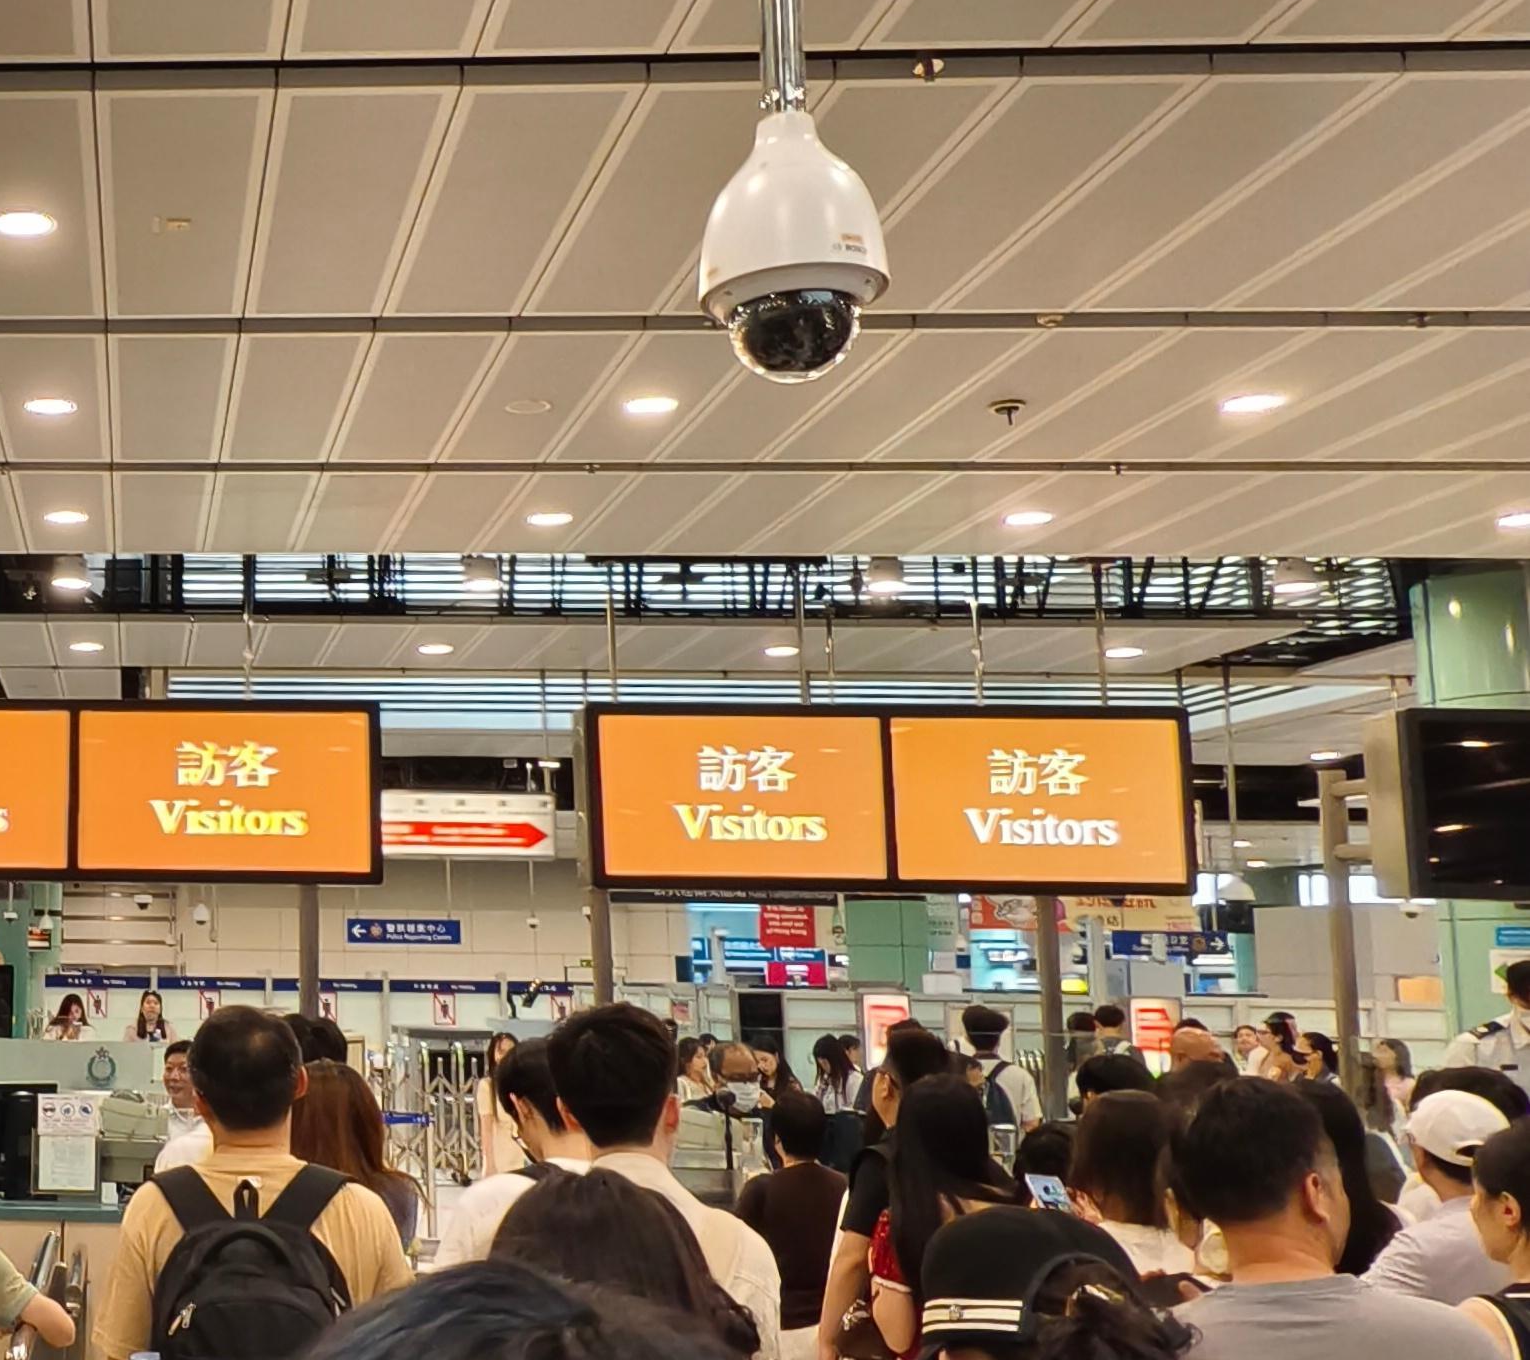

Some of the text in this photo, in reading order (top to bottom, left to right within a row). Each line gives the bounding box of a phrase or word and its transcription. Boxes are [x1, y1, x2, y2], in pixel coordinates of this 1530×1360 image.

[176, 741, 279, 788] 訪客
[697, 745, 796, 793] 訪客
[987, 748, 1088, 796] 訪客
[149, 799, 308, 836] Visitors
[673, 804, 828, 842] Visitors
[964, 807, 1120, 846] Visitors
